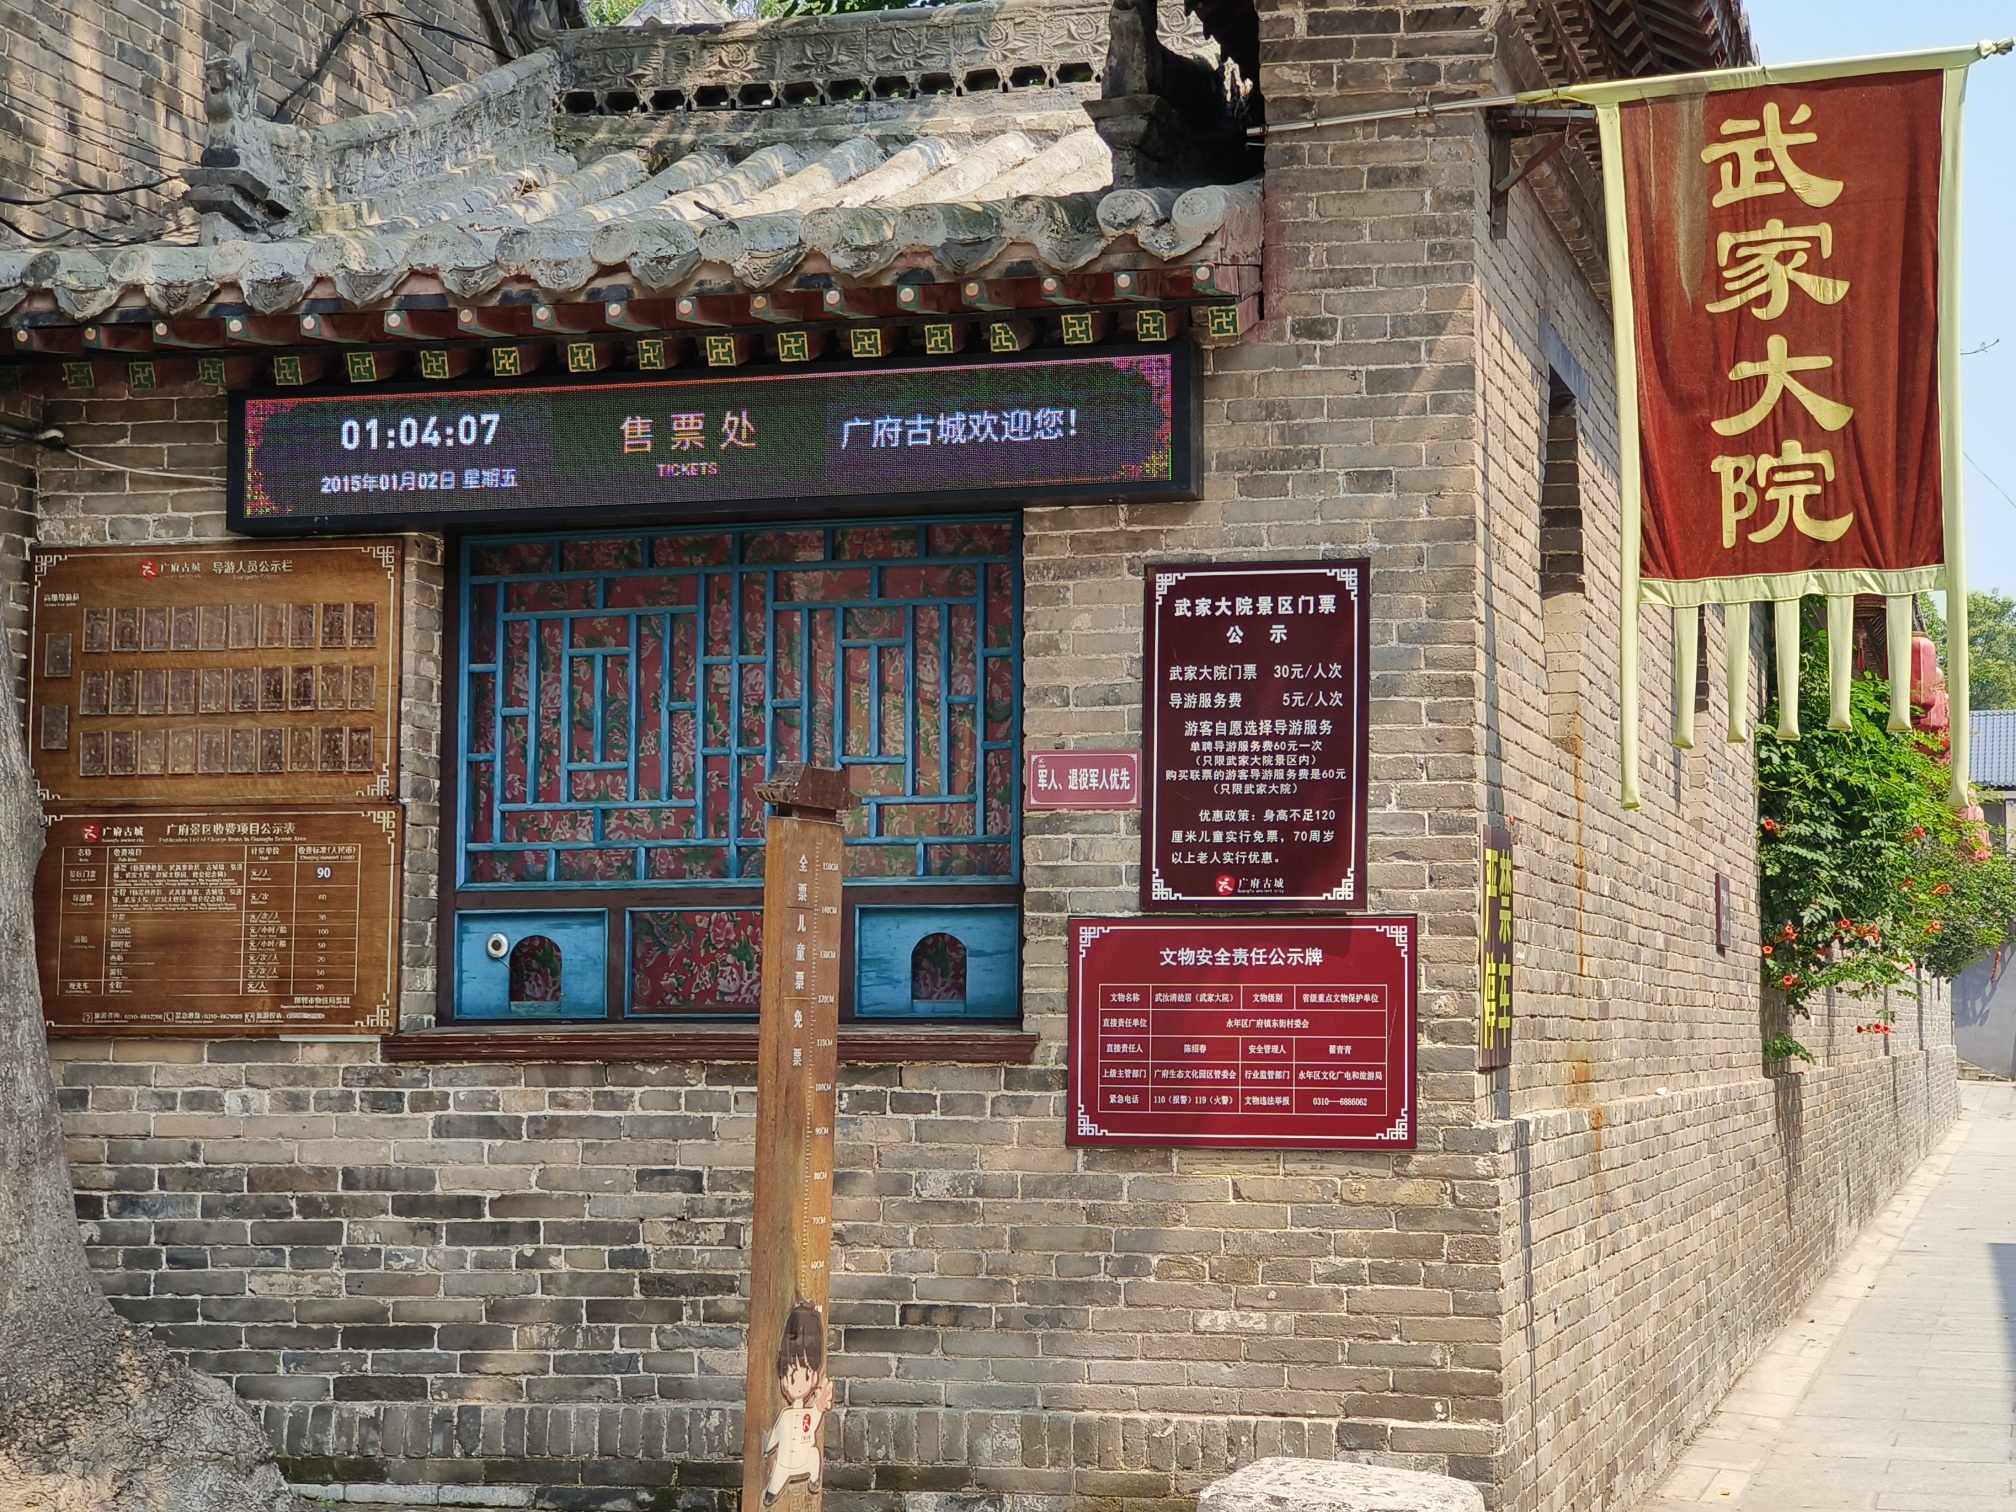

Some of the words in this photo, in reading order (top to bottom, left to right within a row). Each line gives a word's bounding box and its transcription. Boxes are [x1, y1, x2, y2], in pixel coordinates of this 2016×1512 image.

[1700, 101, 1855, 549] 武家大院
[341, 414, 500, 450] 01:04:07
[621, 410, 757, 454] 售票处
[657, 462, 719, 477] TICKETS
[320, 471, 456, 493] 2015年01月02日
[462, 468, 518, 489] 星期五
[161, 562, 201, 573] 广府古城
[213, 560, 293, 574] 导游人员公示栏
[1174, 595, 1337, 617] 武家大院景区门票
[1169, 664, 1258, 682] 武家大院门票
[1274, 662, 1343, 680] 30元/人次
[1169, 693, 1242, 708] 导游服务费
[1282, 691, 1343, 707] 5元/人次
[1184, 720, 1333, 736] 游客自愿选择导游服务
[1190, 740, 1323, 752] 单聘导游服务费60元一次
[1038, 767, 1130, 790] 军人、退役军人优先
[1166, 768, 1347, 781] 购买联票的游客导游服务费是60元
[102, 826, 144, 837] 广府古城
[167, 822, 296, 835] 广府景区收费项目公示表
[1171, 851, 1280, 865] 以上老人实行优惠。
[317, 867, 330, 878] 90
[822, 863, 838, 871] 150CM
[798, 855, 808, 902] 全票
[1239, 878, 1284, 889] 广府古城
[821, 907, 837, 915] 140CM
[794, 914, 807, 990] 儿童票
[820, 951, 836, 959] 130CM
[1159, 947, 1323, 967] 文物安全责任公示牌
[1110, 993, 1140, 1002] 文物名称
[1253, 993, 1283, 1003] 文物级别
[1303, 993, 1378, 1003] 省级重点文物保护单位
[1103, 1018, 1148, 1028] 直接责任单位
[1226, 1018, 1309, 1030] 永年区广府镇东街村委会
[792, 1009, 803, 1067] 免票
[1106, 1044, 1143, 1053] 直接责任人
[1249, 1045, 1286, 1054] 安全管理人
[1102, 1069, 1146, 1078] 上级主管部门
[1154, 1070, 1236, 1079] 广府生态文化园区管委会
[1245, 1070, 1290, 1079] 行业监管部门
[1298, 1071, 1382, 1081] 永年区文化广电和旅游局
[1109, 1094, 1139, 1104] 紧急电话
[1245, 1096, 1290, 1106] 文物违法举报
[815, 1127, 829, 1135] 90CM
[813, 1172, 827, 1180] 80CM
[813, 1217, 826, 1225] 70CM
[810, 1261, 824, 1269] 60CM
